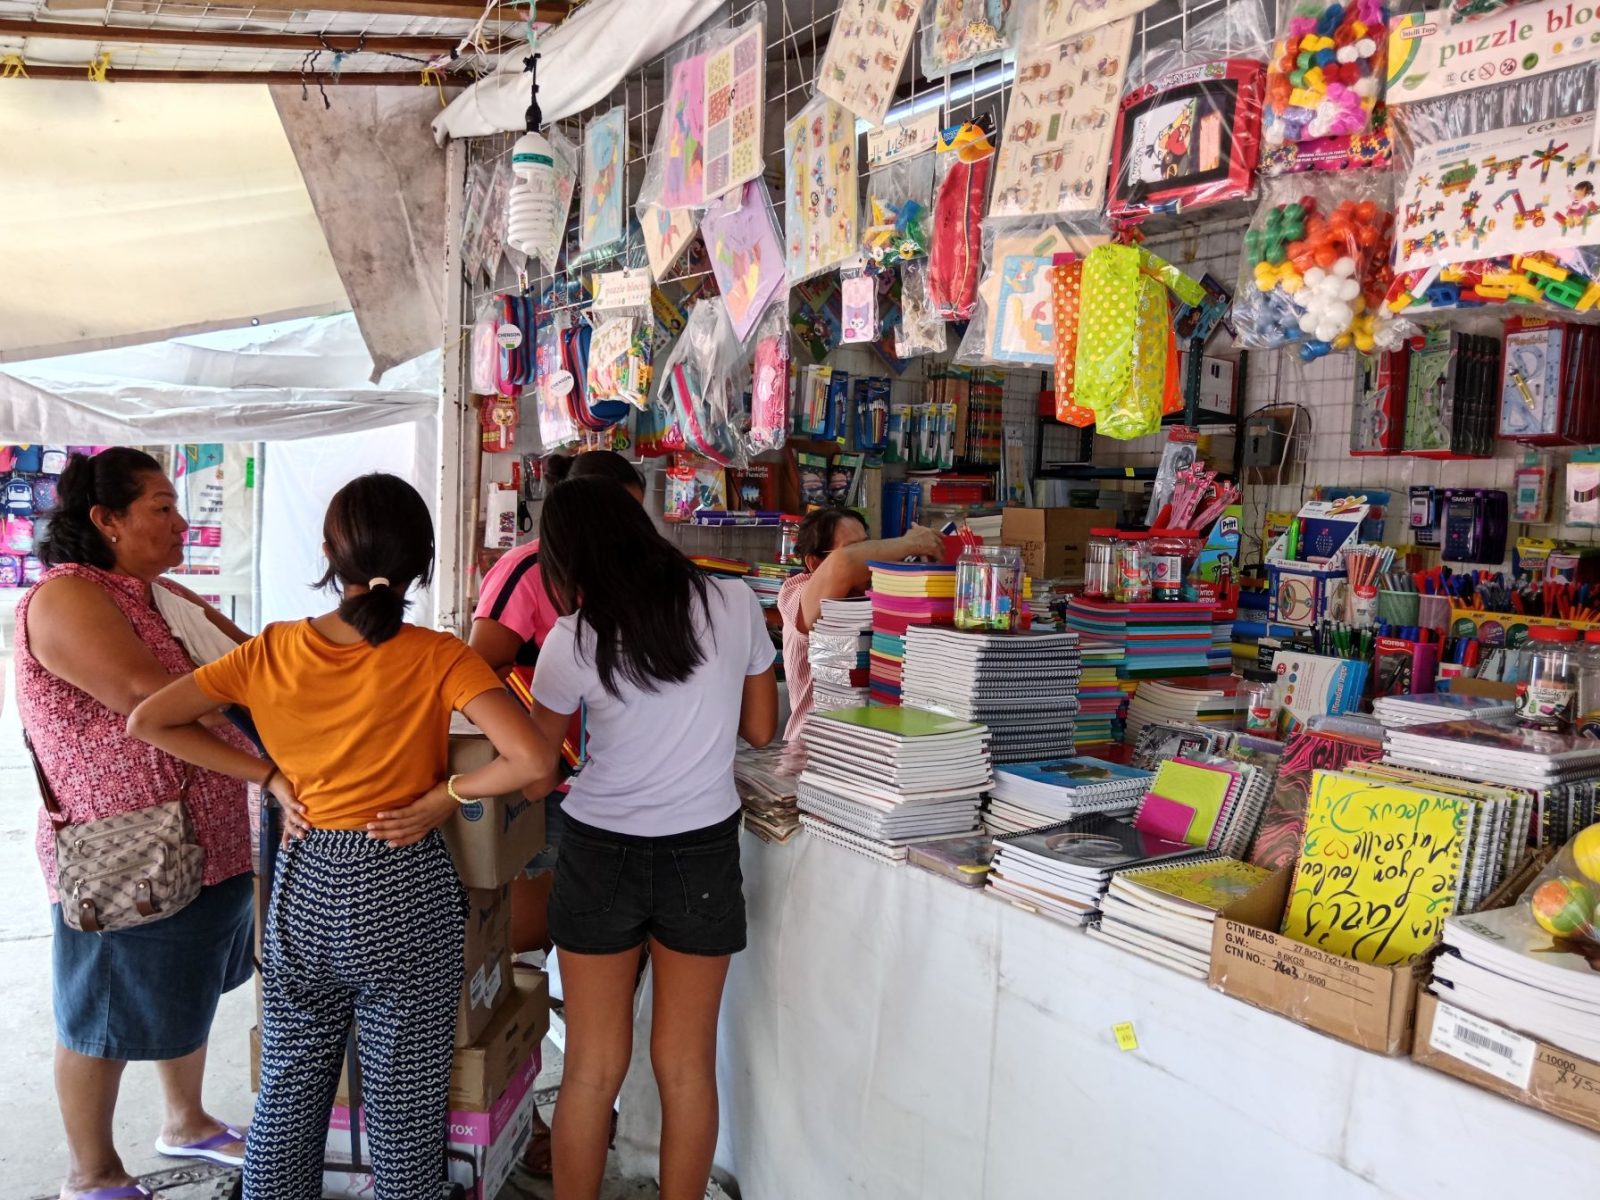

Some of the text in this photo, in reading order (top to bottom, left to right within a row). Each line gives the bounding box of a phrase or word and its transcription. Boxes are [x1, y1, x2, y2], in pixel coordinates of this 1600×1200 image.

[1438, 19, 1533, 68] puzzle
[1222, 519, 1237, 529] Pritt
[504, 798, 531, 834] Norm
[1353, 831, 1457, 865] Marseille
[1301, 861, 1361, 902] Toulou
[1373, 850, 1425, 908] Lyon
[1225, 921, 1246, 935] CTN
[1247, 927, 1278, 946] MEAS:
[1225, 932, 1249, 948] G.W.:
[1303, 901, 1410, 962] Paris
[1224, 944, 1266, 966] CTN NO.:
[1546, 1055, 1576, 1073] 10000
